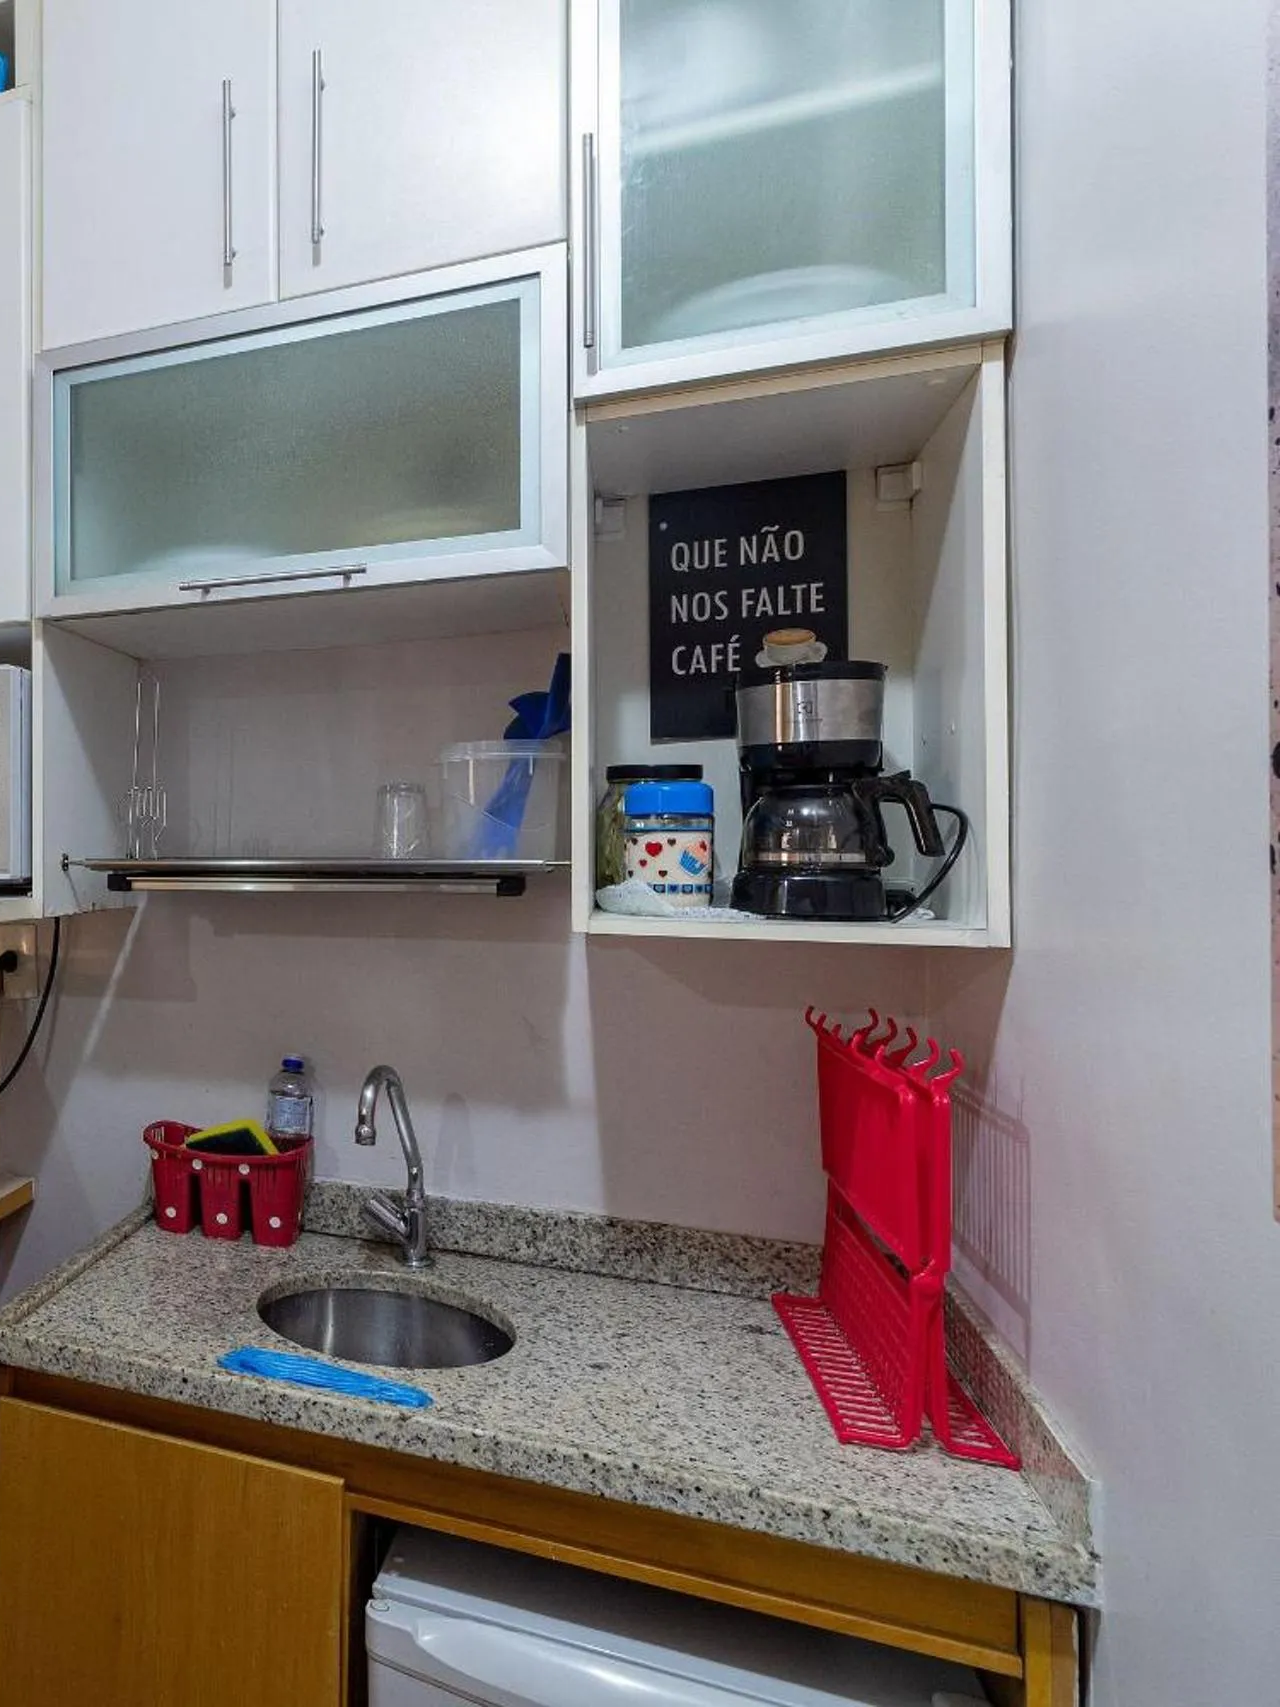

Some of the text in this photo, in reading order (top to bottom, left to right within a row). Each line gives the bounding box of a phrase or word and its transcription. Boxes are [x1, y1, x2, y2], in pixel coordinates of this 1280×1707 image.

[671, 525, 805, 572] QUE NÃO
[671, 582, 825, 624] NOS FALTE
[671, 634, 742, 675] CAFÉ
